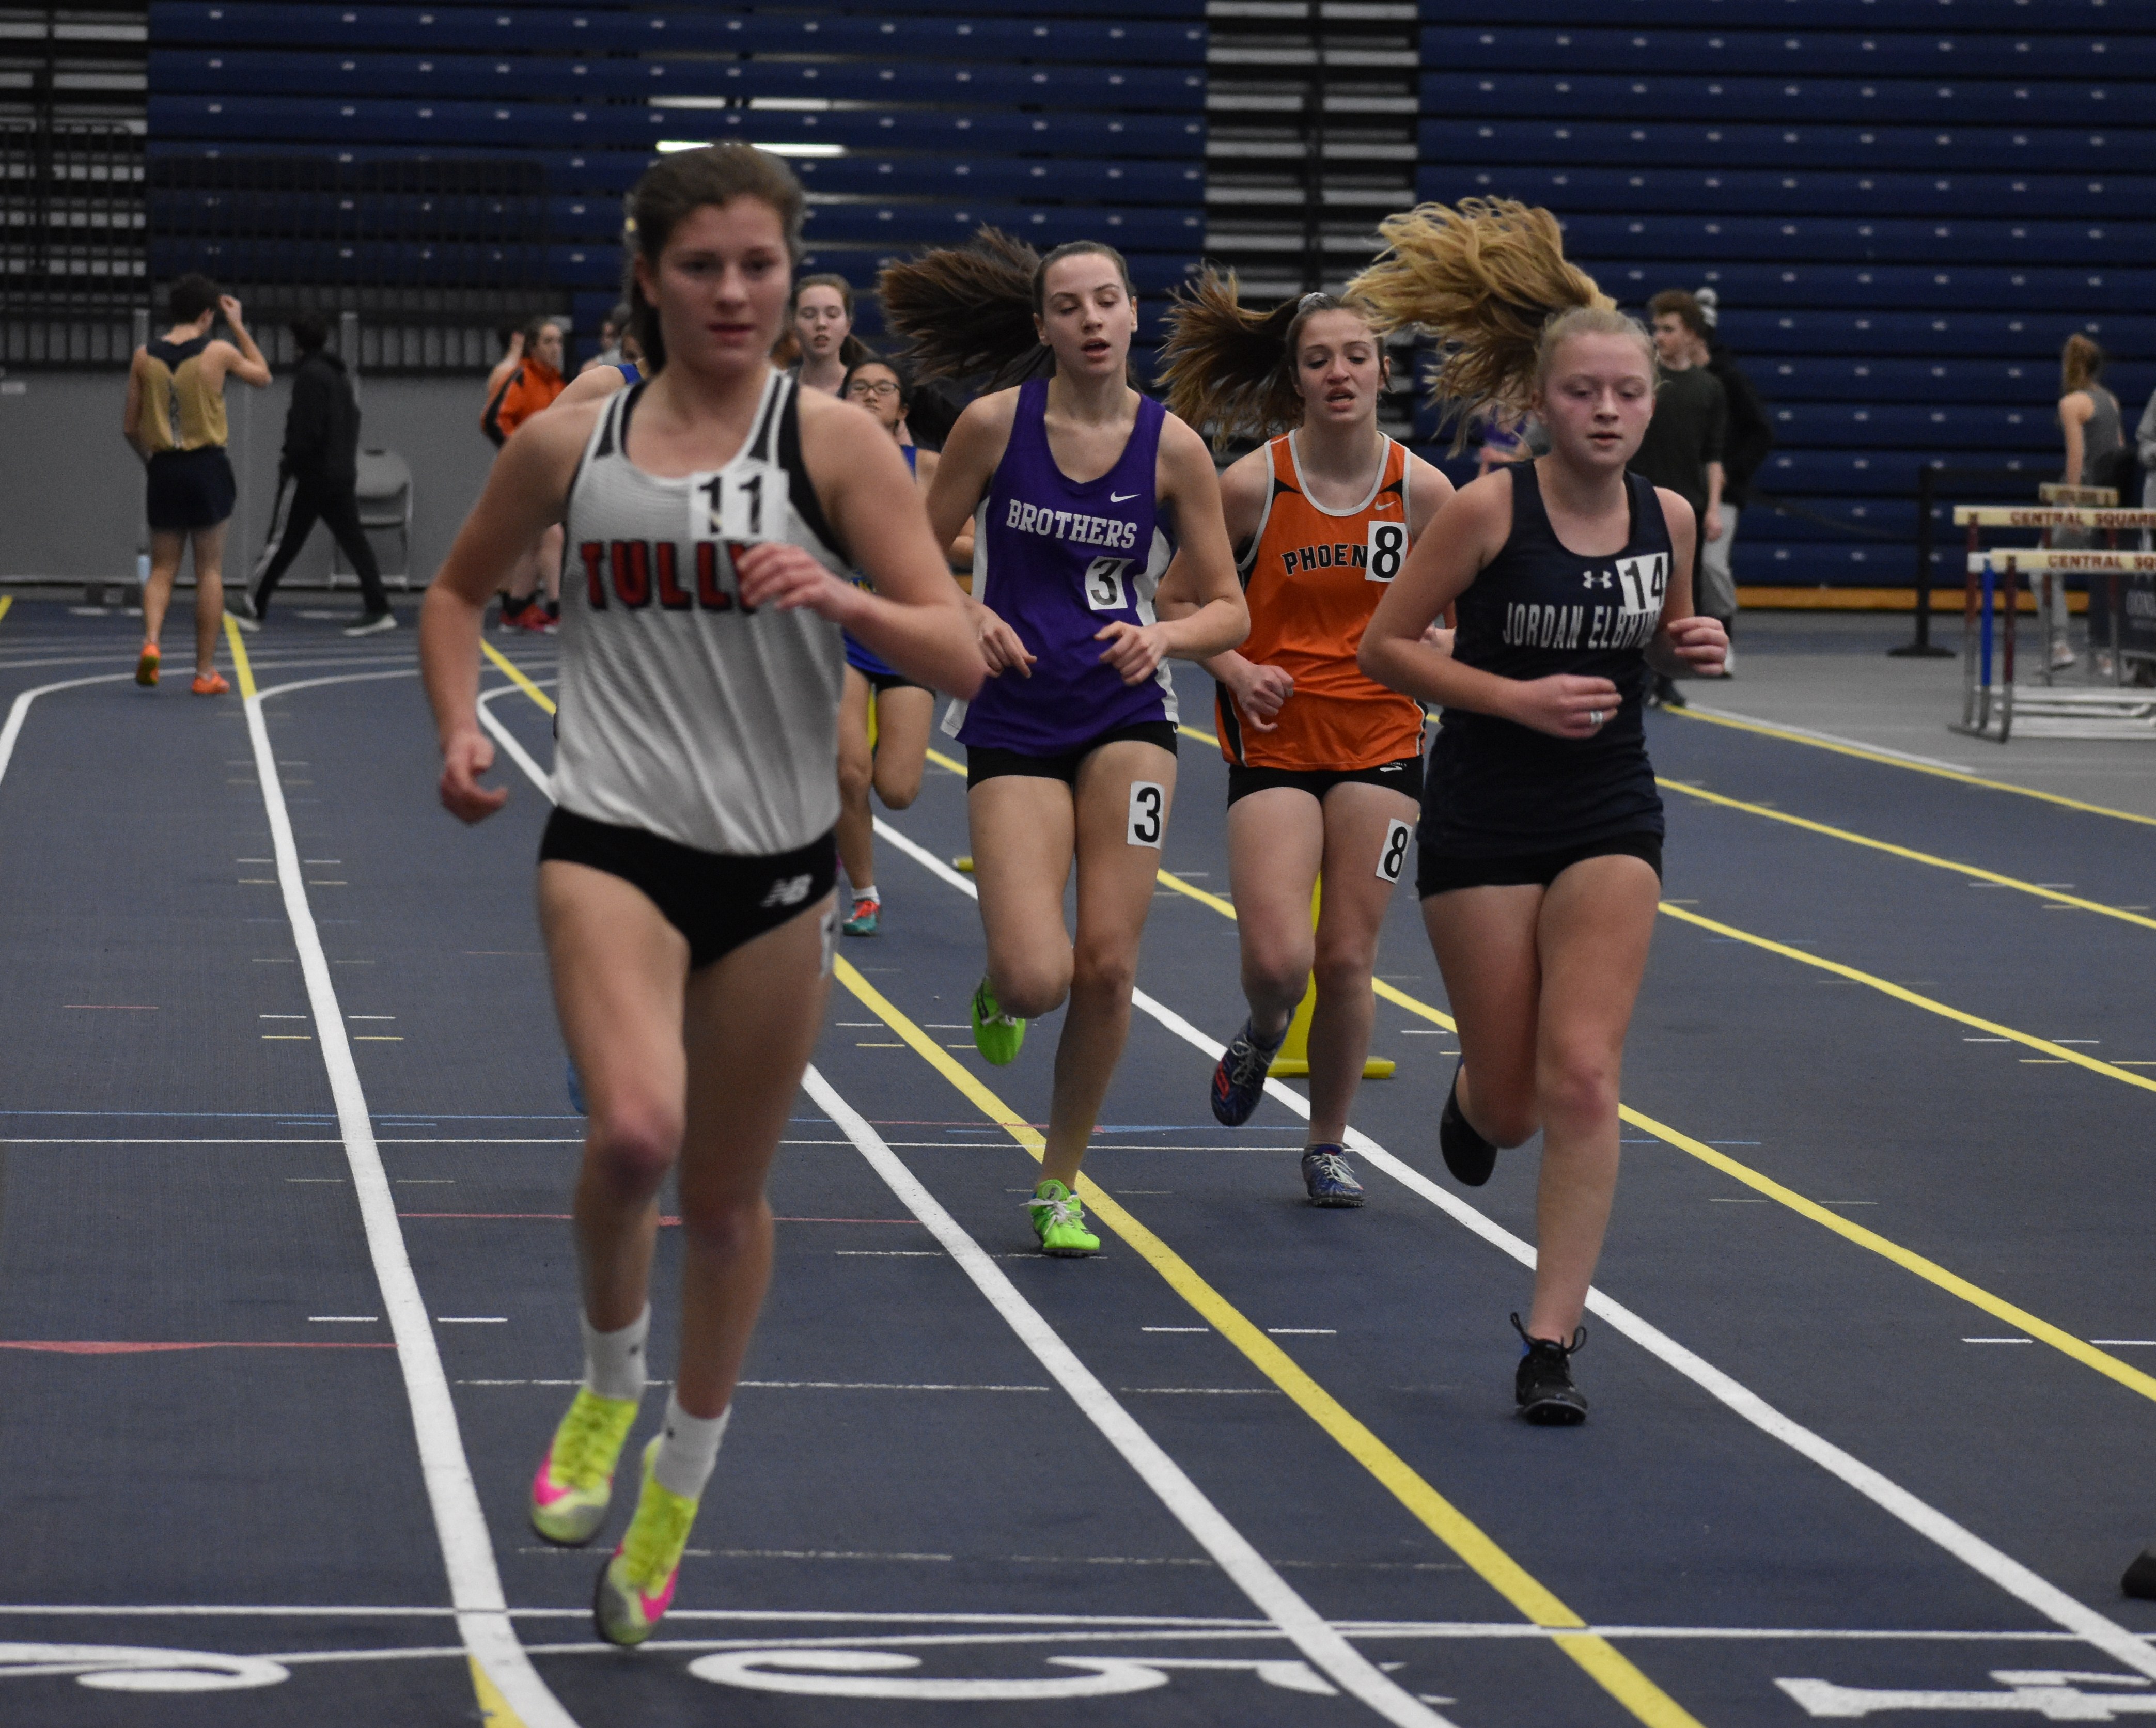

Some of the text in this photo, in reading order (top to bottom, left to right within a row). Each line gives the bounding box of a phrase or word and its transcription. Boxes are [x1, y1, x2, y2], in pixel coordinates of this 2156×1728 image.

[697, 474, 762, 535] 11
[1006, 498, 1137, 549] BROTHERS
[1372, 526, 1403, 579] 8
[2048, 554, 2122, 568] CENTRAL
[1090, 559, 1121, 606] 3
[1623, 556, 1664, 610] 14
[1502, 602, 1584, 649] JORDAN
[1134, 787, 1161, 843] 3
[1383, 826, 1408, 879] 8
